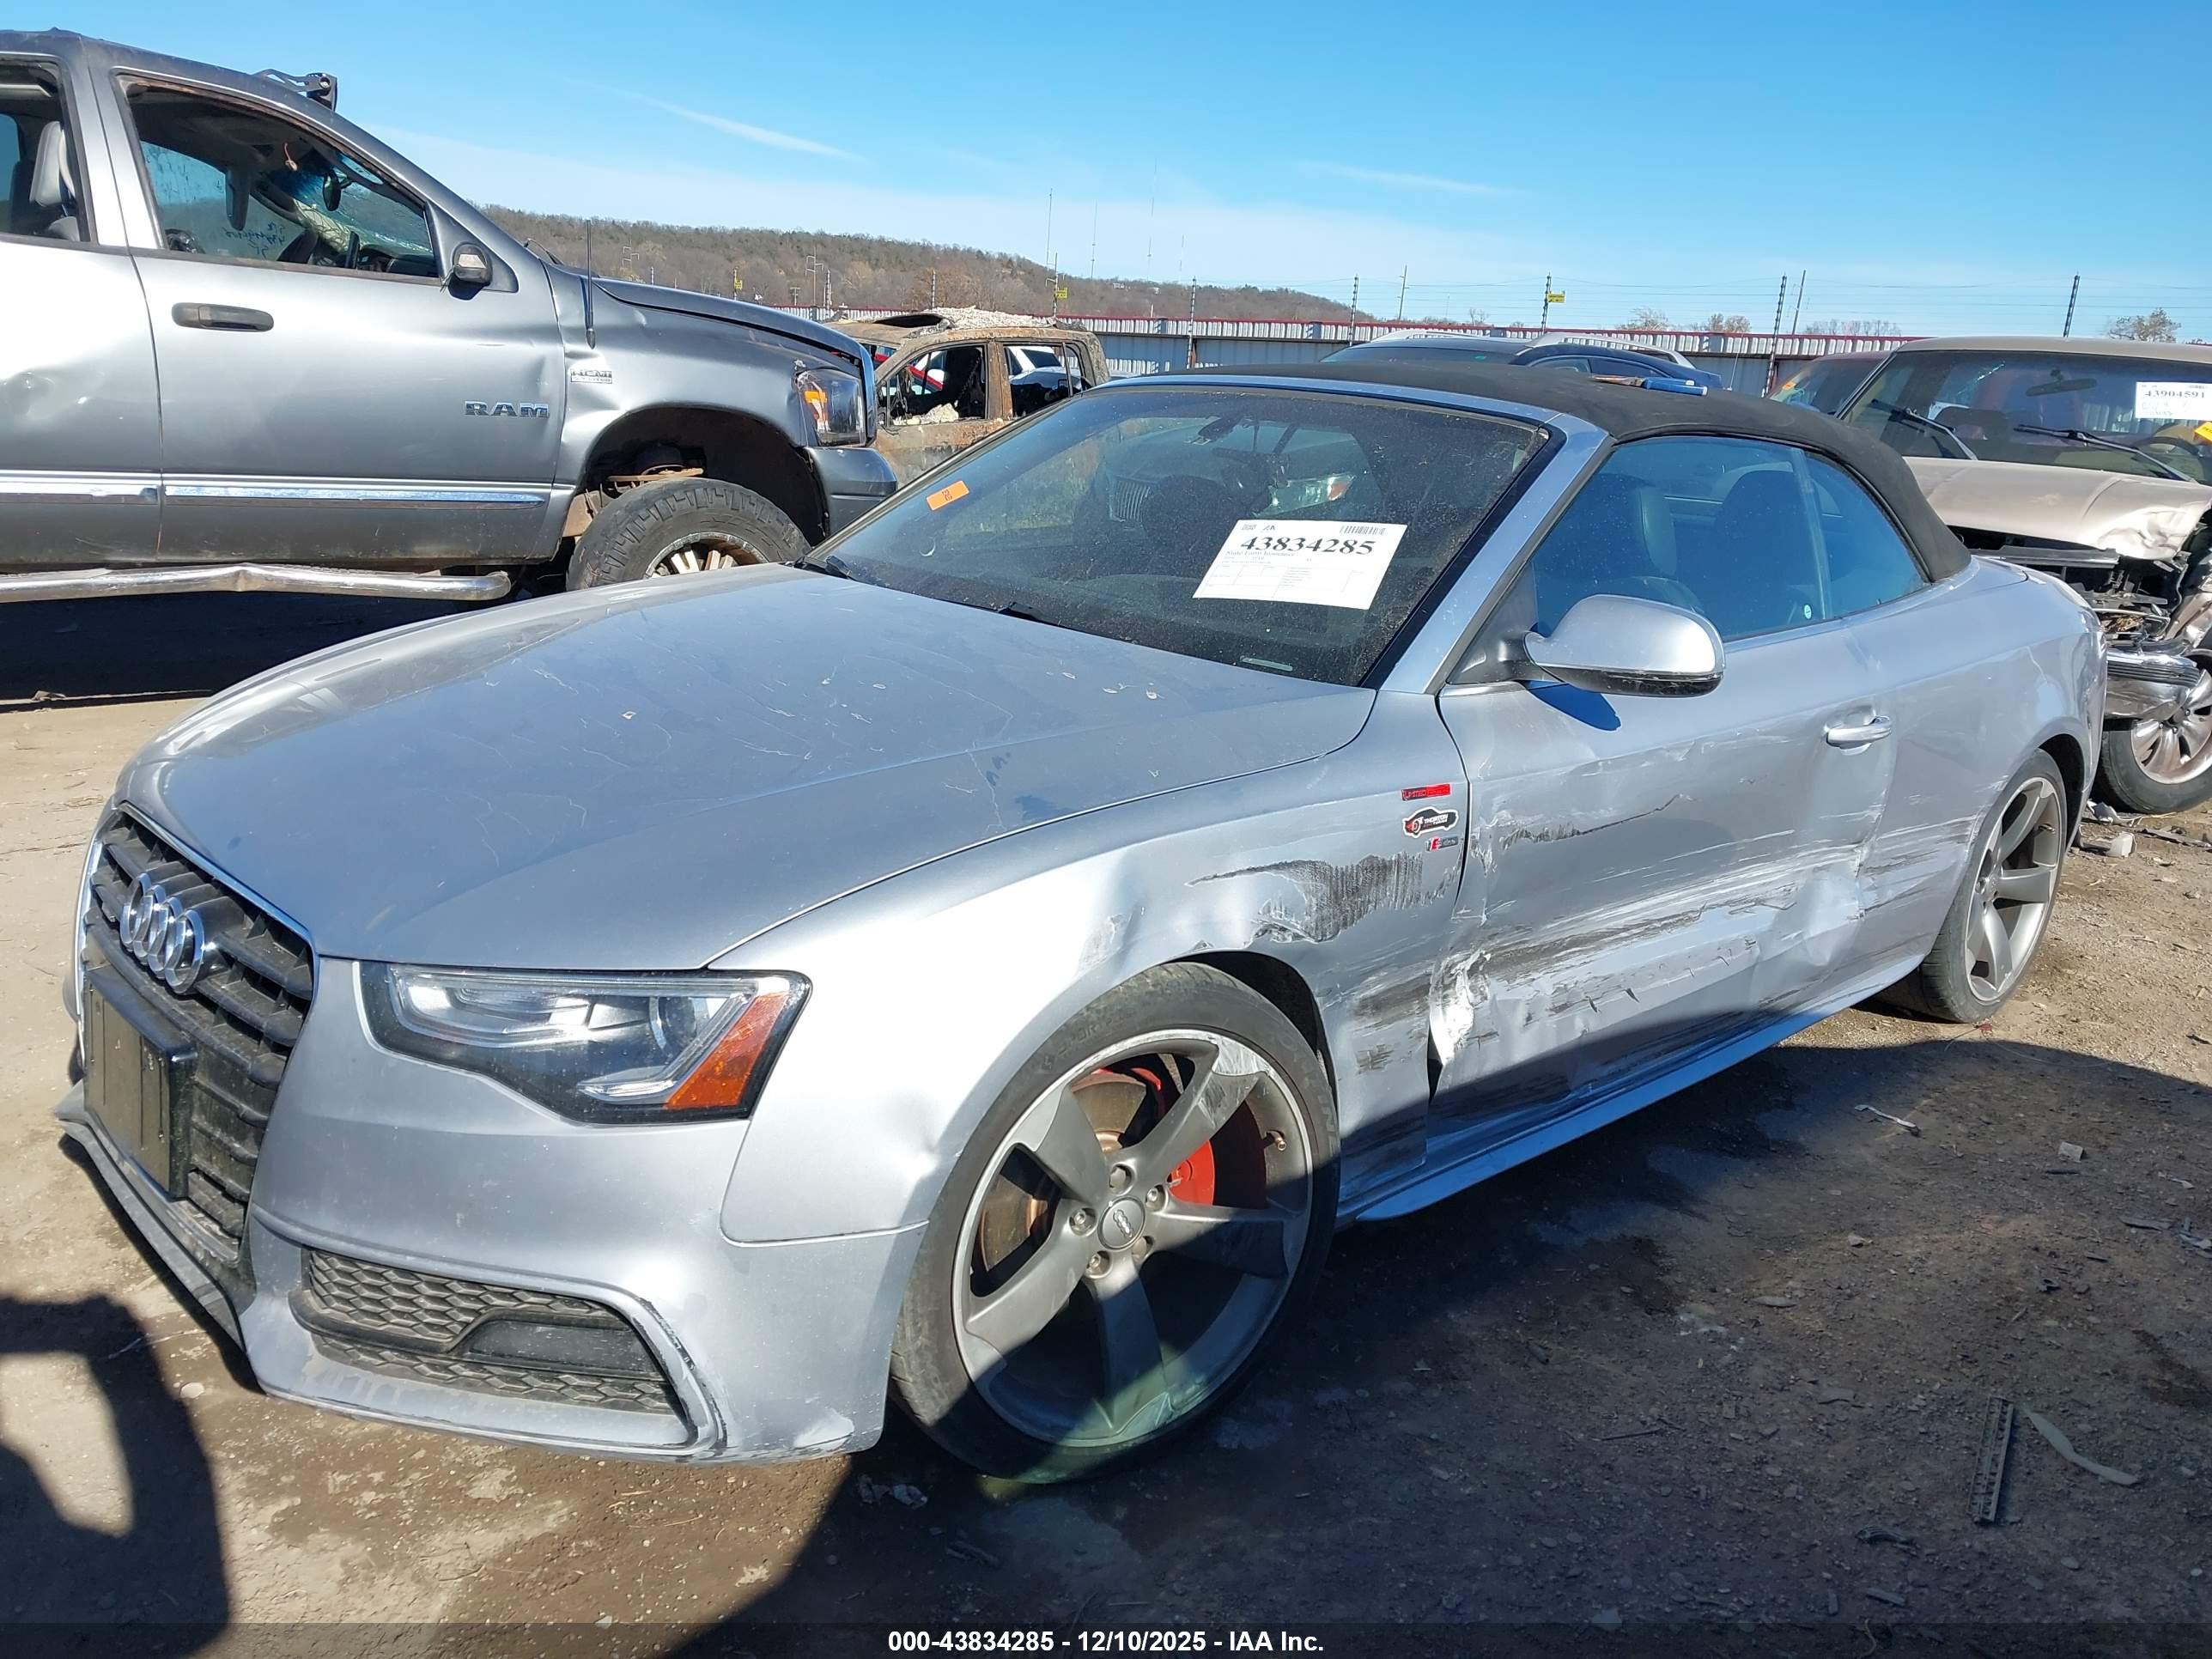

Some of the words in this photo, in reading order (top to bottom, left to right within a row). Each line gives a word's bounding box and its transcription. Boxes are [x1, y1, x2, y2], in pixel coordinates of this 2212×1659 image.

[2145, 390, 2205, 398] 43904591
[465, 400, 549, 417] RAM
[1241, 537, 1376, 555] 43834285
